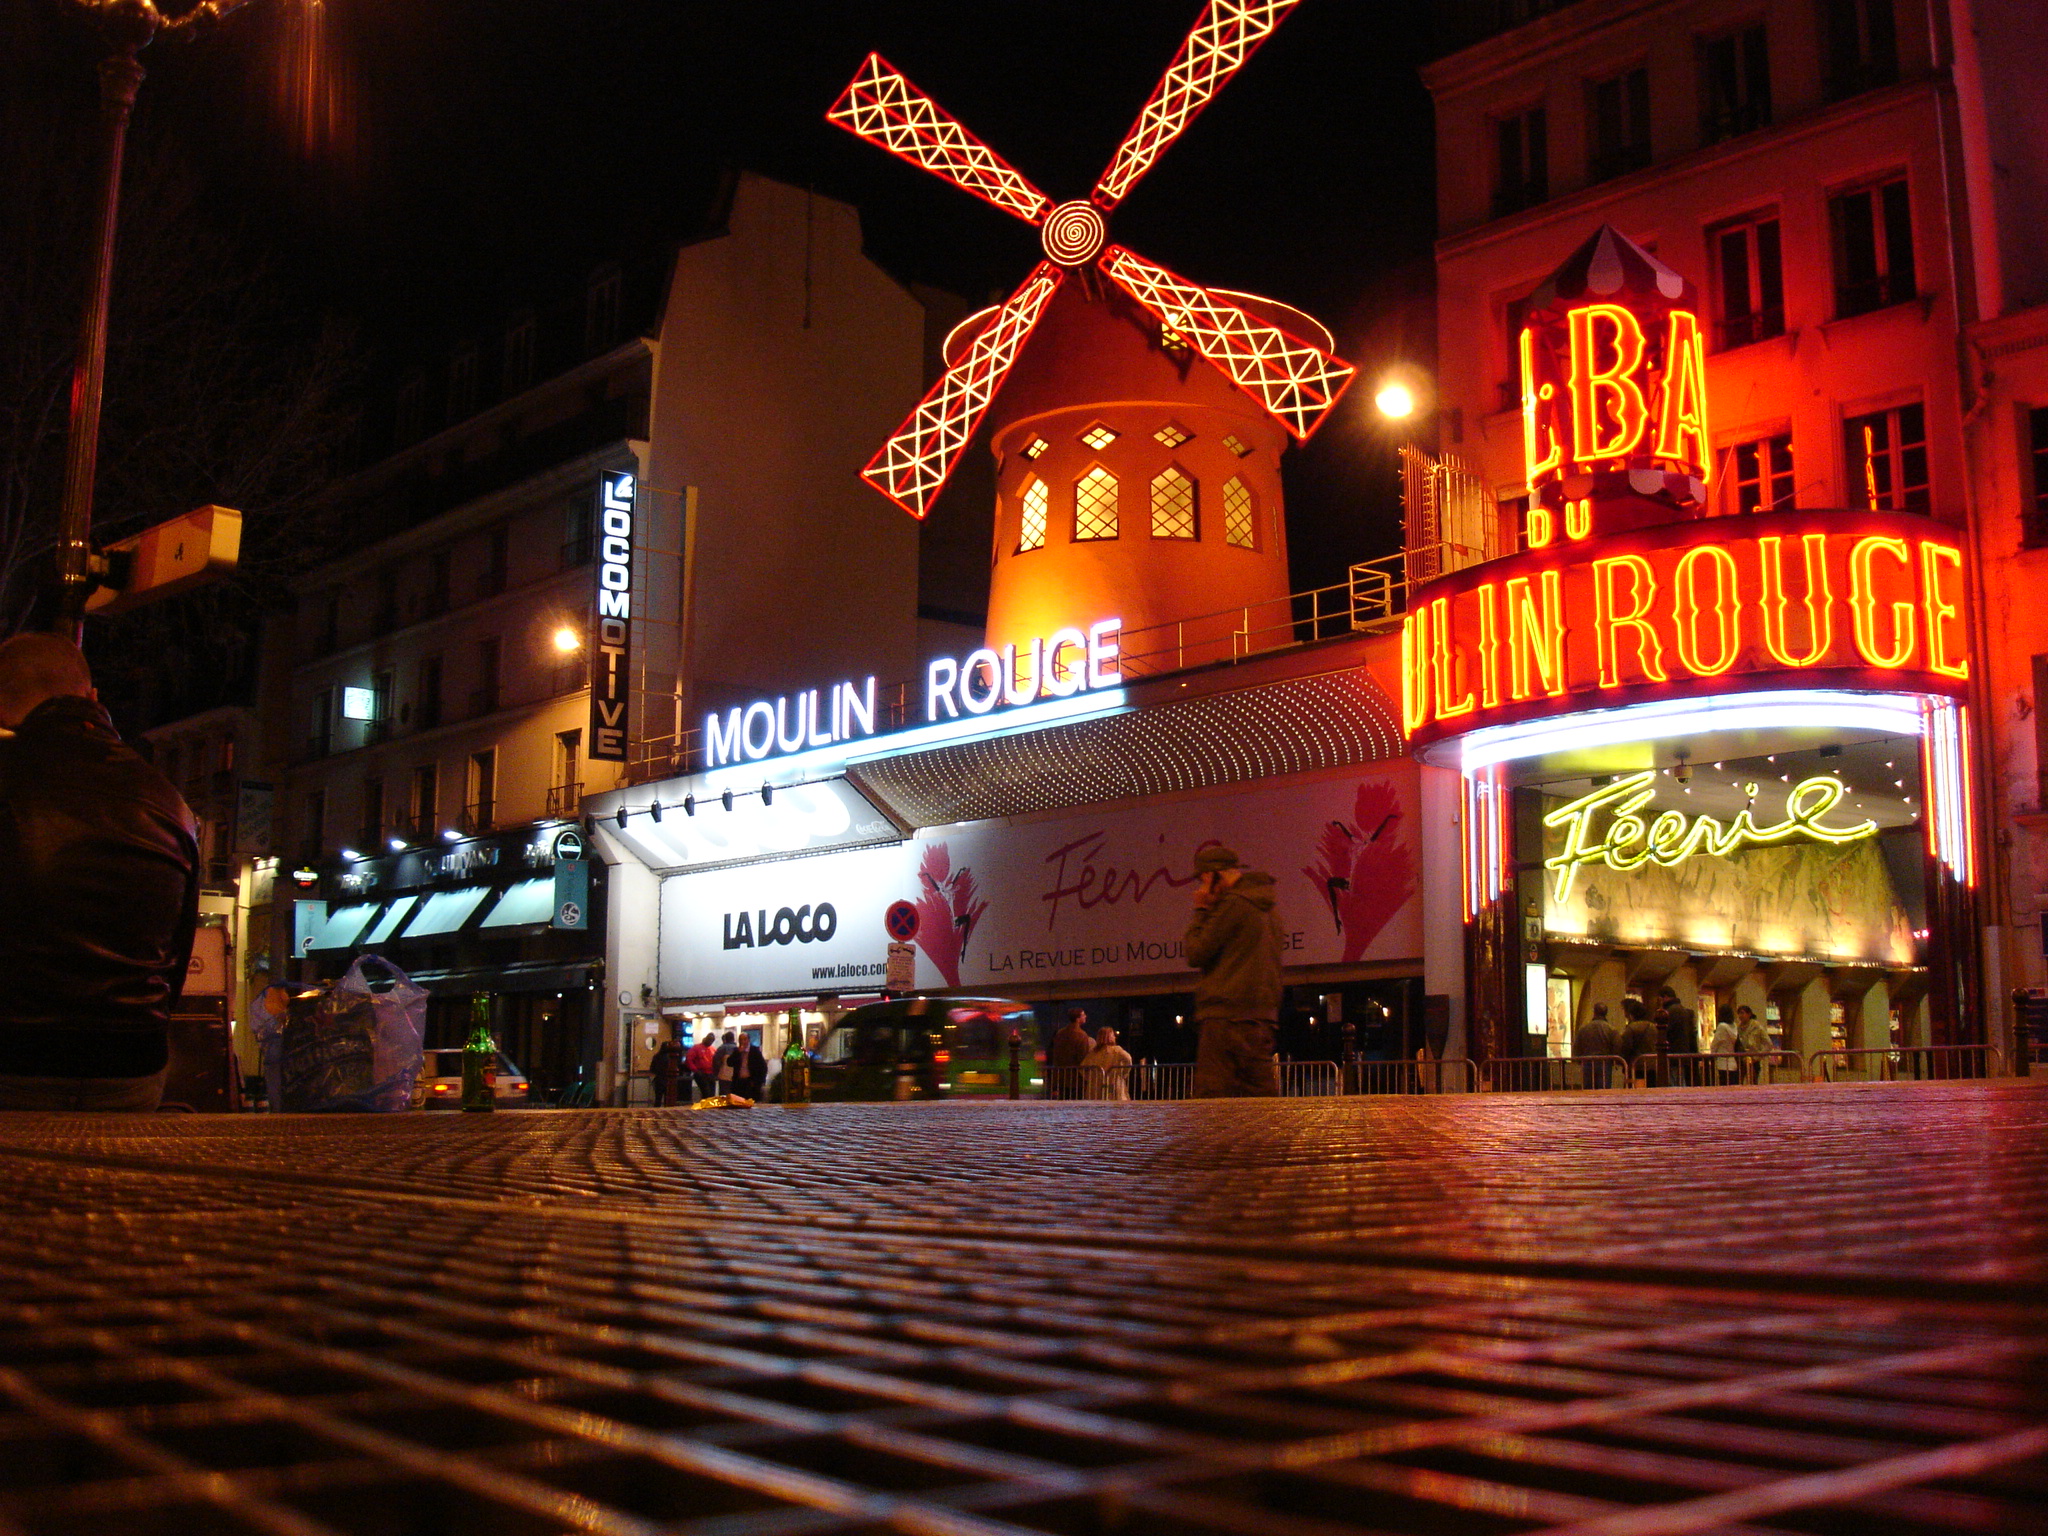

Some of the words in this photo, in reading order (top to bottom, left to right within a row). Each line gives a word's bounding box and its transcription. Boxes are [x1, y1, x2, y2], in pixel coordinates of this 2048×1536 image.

[1527, 499, 1590, 548] DU
[597, 481, 631, 755] LOCOMOTIVE
[1402, 571, 1563, 741] ULIN
[1592, 533, 1968, 688] ROUGE
[706, 675, 878, 768] MOULIN
[927, 617, 1122, 722] ROUGE
[723, 911, 755, 951] LA
[757, 902, 838, 948] LOCO
[1020, 949, 1085, 969] REVUE
[1092, 946, 1119, 964] DU
[1127, 940, 1185, 962] MOUL
